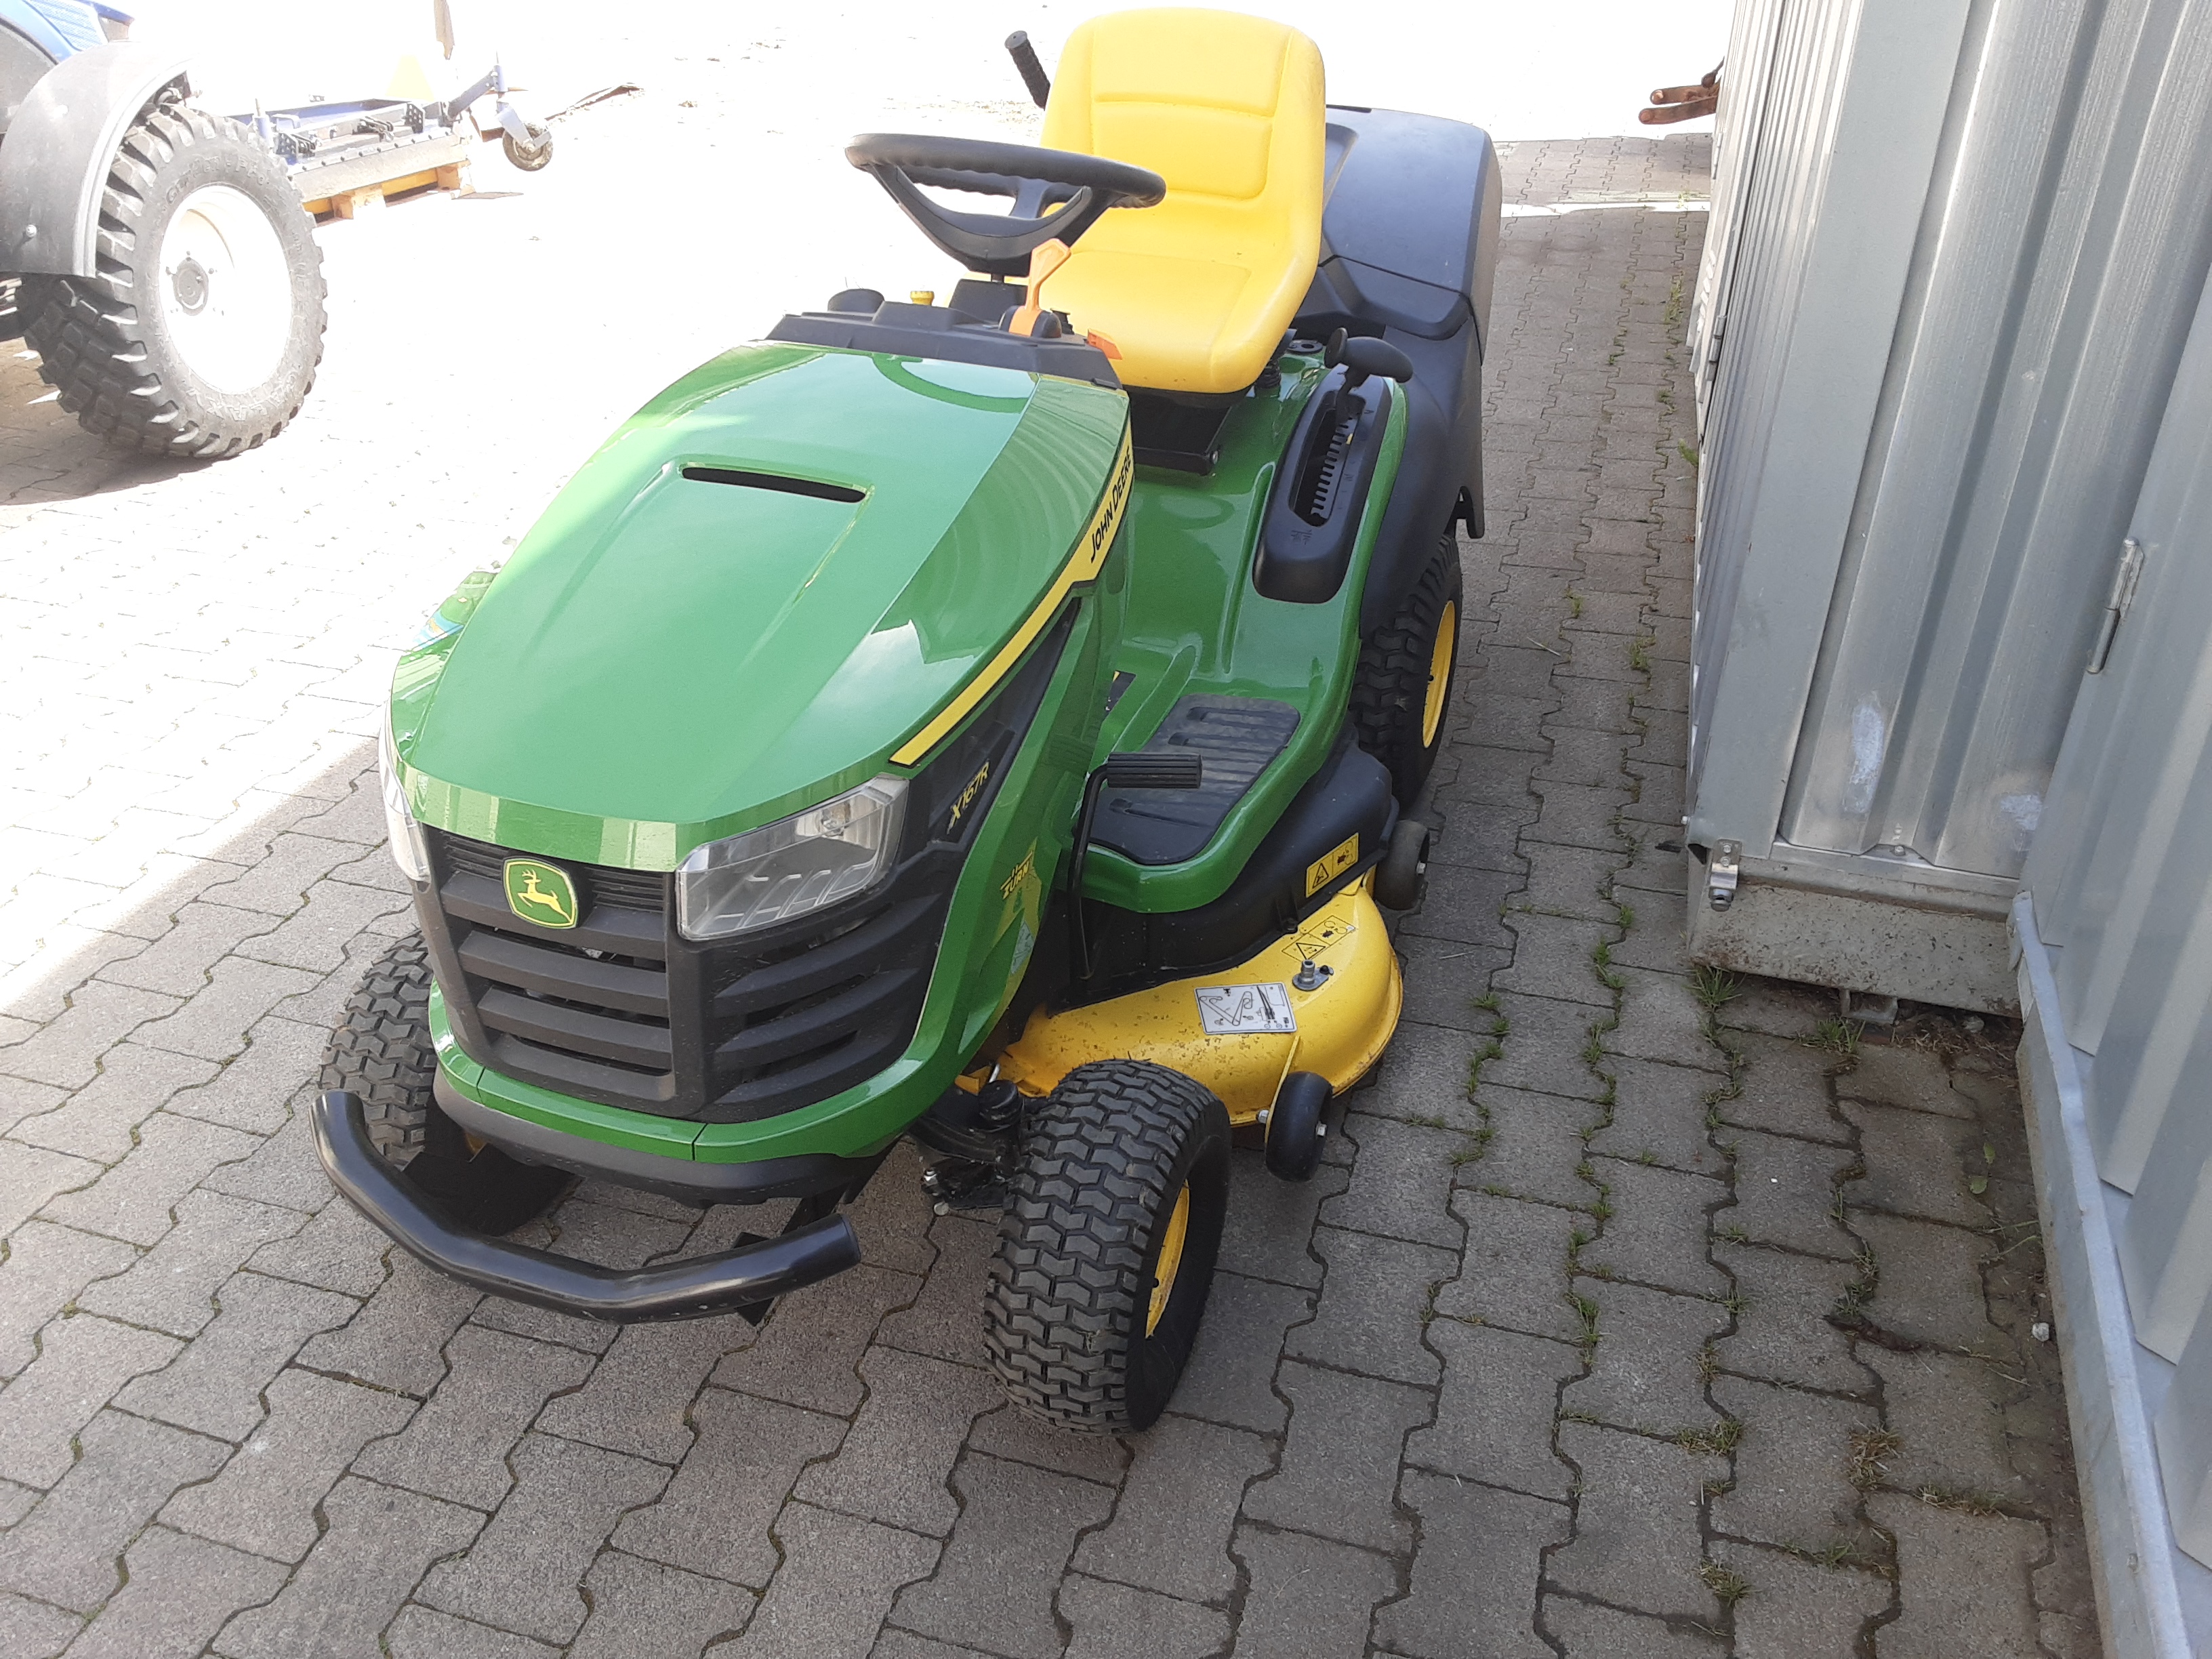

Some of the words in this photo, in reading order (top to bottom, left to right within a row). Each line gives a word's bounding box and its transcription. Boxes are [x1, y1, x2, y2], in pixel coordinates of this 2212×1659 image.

[1090, 501, 1113, 564] JOHN
[1112, 445, 1131, 513] DEERE
[947, 760, 989, 834] X167R
